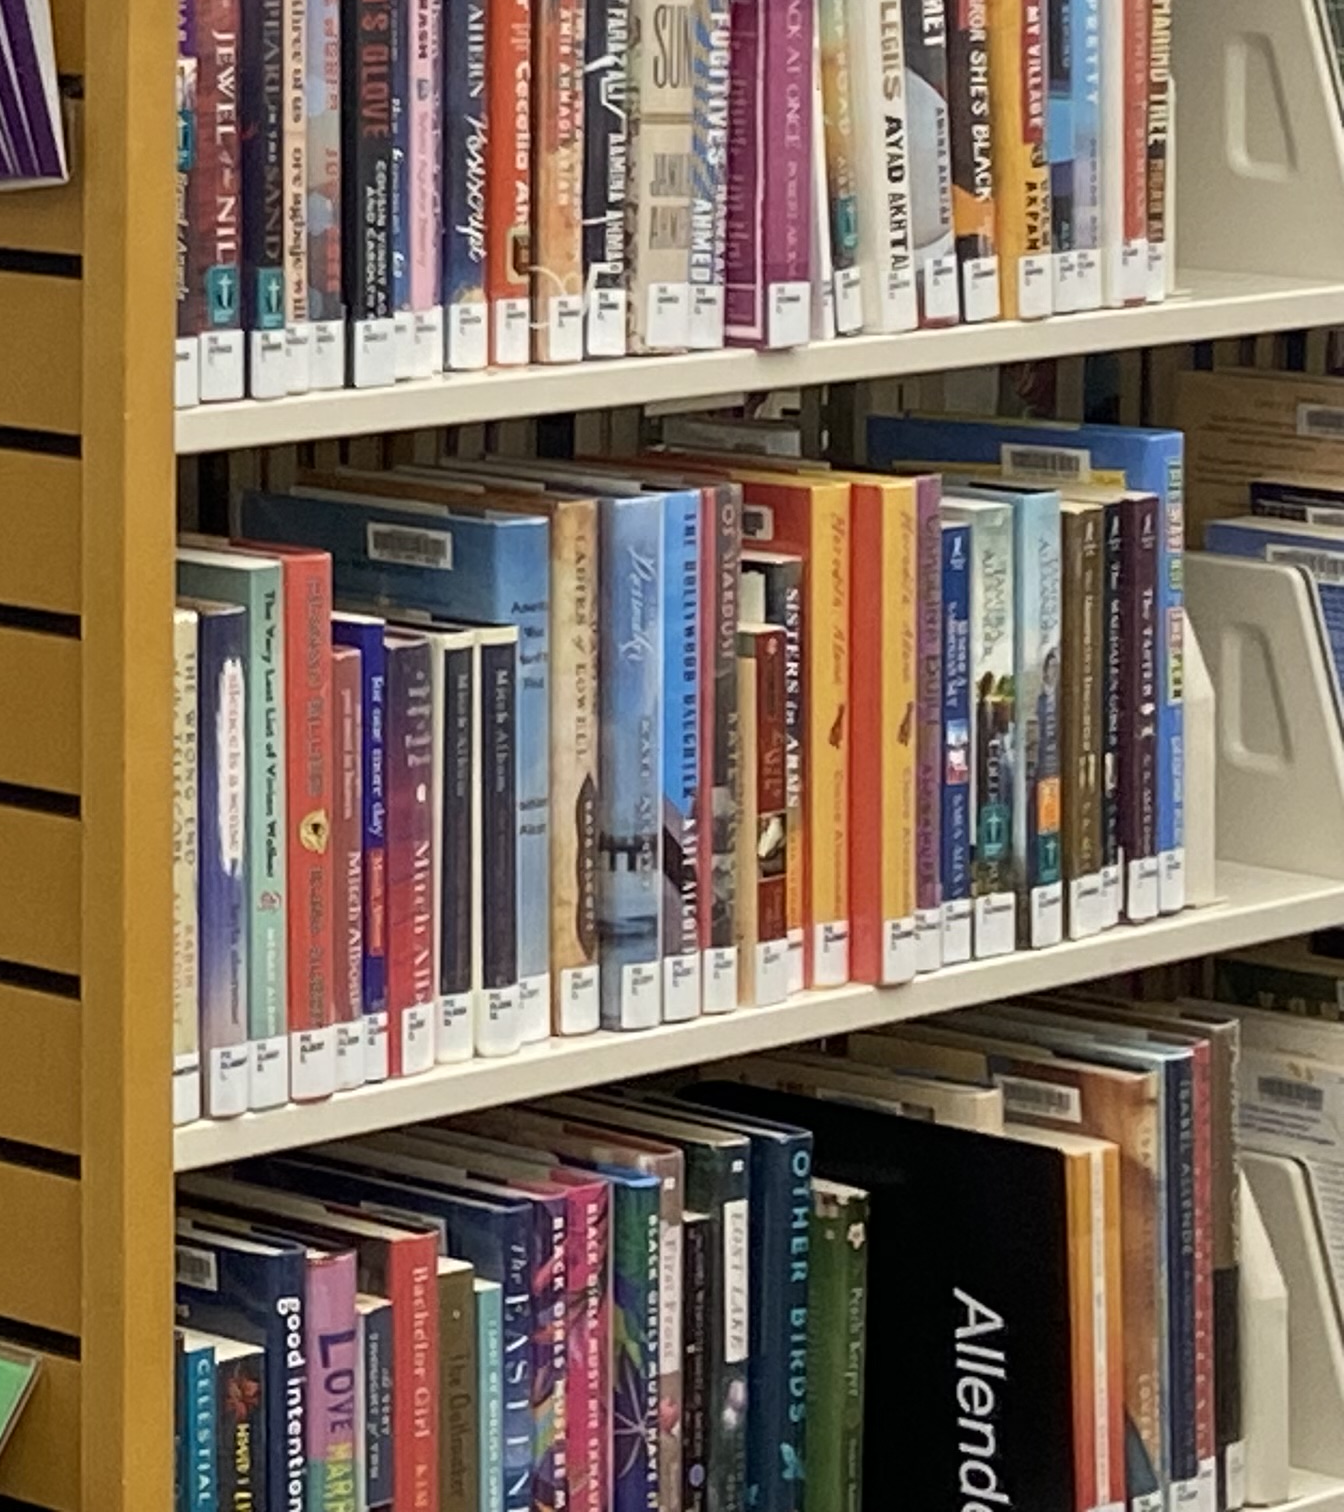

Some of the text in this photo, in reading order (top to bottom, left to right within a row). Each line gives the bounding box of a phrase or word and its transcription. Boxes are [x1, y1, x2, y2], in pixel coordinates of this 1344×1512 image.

[290, 0, 304, 63] three
[466, 4, 484, 99] AHERN
[785, 48, 802, 78] AT
[1027, 6, 1041, 39] MY
[212, 28, 237, 145] JEWEL
[360, 43, 388, 139] GLOVE
[514, 60, 531, 170] Cecelia
[707, 12, 731, 165] FUGITIVES
[784, 83, 801, 149] ONCE
[969, 49, 990, 117] SHE'S
[1028, 45, 1043, 129] VILLAGE
[1148, 93, 1168, 147] TREE
[455, 113, 487, 262] Postscript
[884, 115, 903, 184] AYAD
[972, 123, 992, 202] BLACK
[690, 199, 712, 282] AHMED
[1025, 180, 1040, 251] AKPAN
[784, 587, 800, 807] SISTERS in ARMS
[413, 840, 430, 928] Mitch
[586, 1203, 598, 1266] BLACK
[730, 1212, 745, 1351] LOST LAKE
[788, 1150, 809, 1424] OTHER BIRDS
[276, 1296, 303, 1368] good
[412, 1266, 431, 1438] Bachelor Girl
[553, 1217, 565, 1478] BLACK GIRLS MUST BE
[318, 1328, 356, 1435] LOVE
[197, 1358, 212, 1506] CELESTIAL
